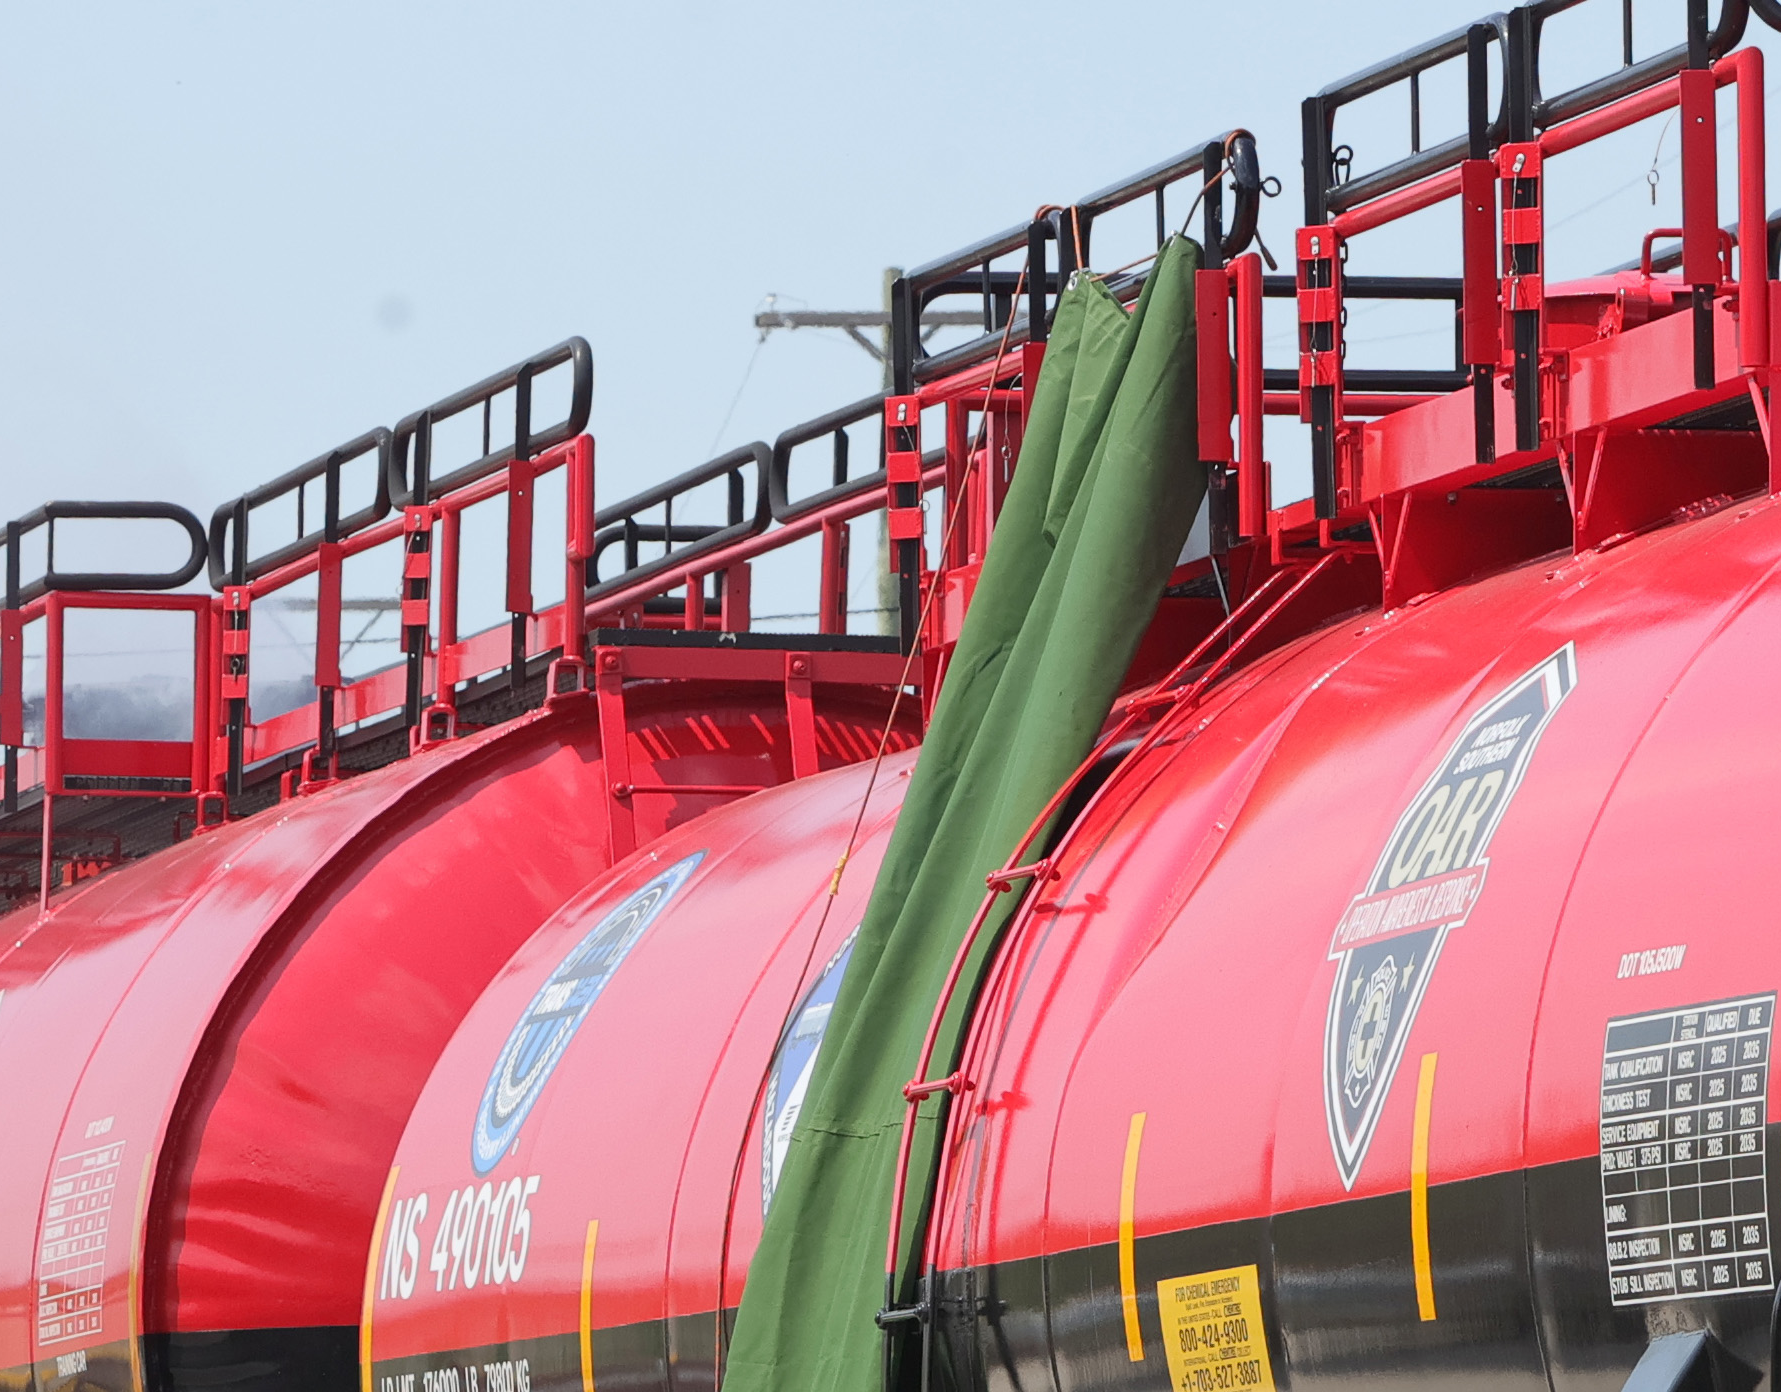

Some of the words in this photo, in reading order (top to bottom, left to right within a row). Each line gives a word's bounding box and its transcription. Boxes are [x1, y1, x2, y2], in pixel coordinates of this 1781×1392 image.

[1387, 769, 1505, 889] OAR
[1616, 952, 1640, 979] DOT
[1706, 1011, 1737, 1032] QUALIFIED
[1748, 1007, 1762, 1025] DUE
[1604, 1062, 1619, 1080] TANK
[1620, 1055, 1664, 1079] QUALIFICATION
[1743, 1040, 1760, 1059] 2035
[1635, 1089, 1651, 1108] TEST
[1741, 1074, 1758, 1093] 2035
[1602, 1126, 1625, 1145] SERVICE
[1740, 1106, 1756, 1126] 2035
[1740, 1133, 1755, 1152] 2035
[380, 1192, 428, 1301] NS
[429, 1174, 541, 1292] 490105
[1628, 1237, 1660, 1258] INSPECTION
[1743, 1225, 1760, 1244] 2035
[1611, 1276, 1629, 1295] STUB
[1630, 1273, 1643, 1293] SILL
[1644, 1271, 1674, 1291] INSPECTION
[1746, 1261, 1762, 1280] 2035
[1179, 1317, 1249, 1353] 800-424-9300
